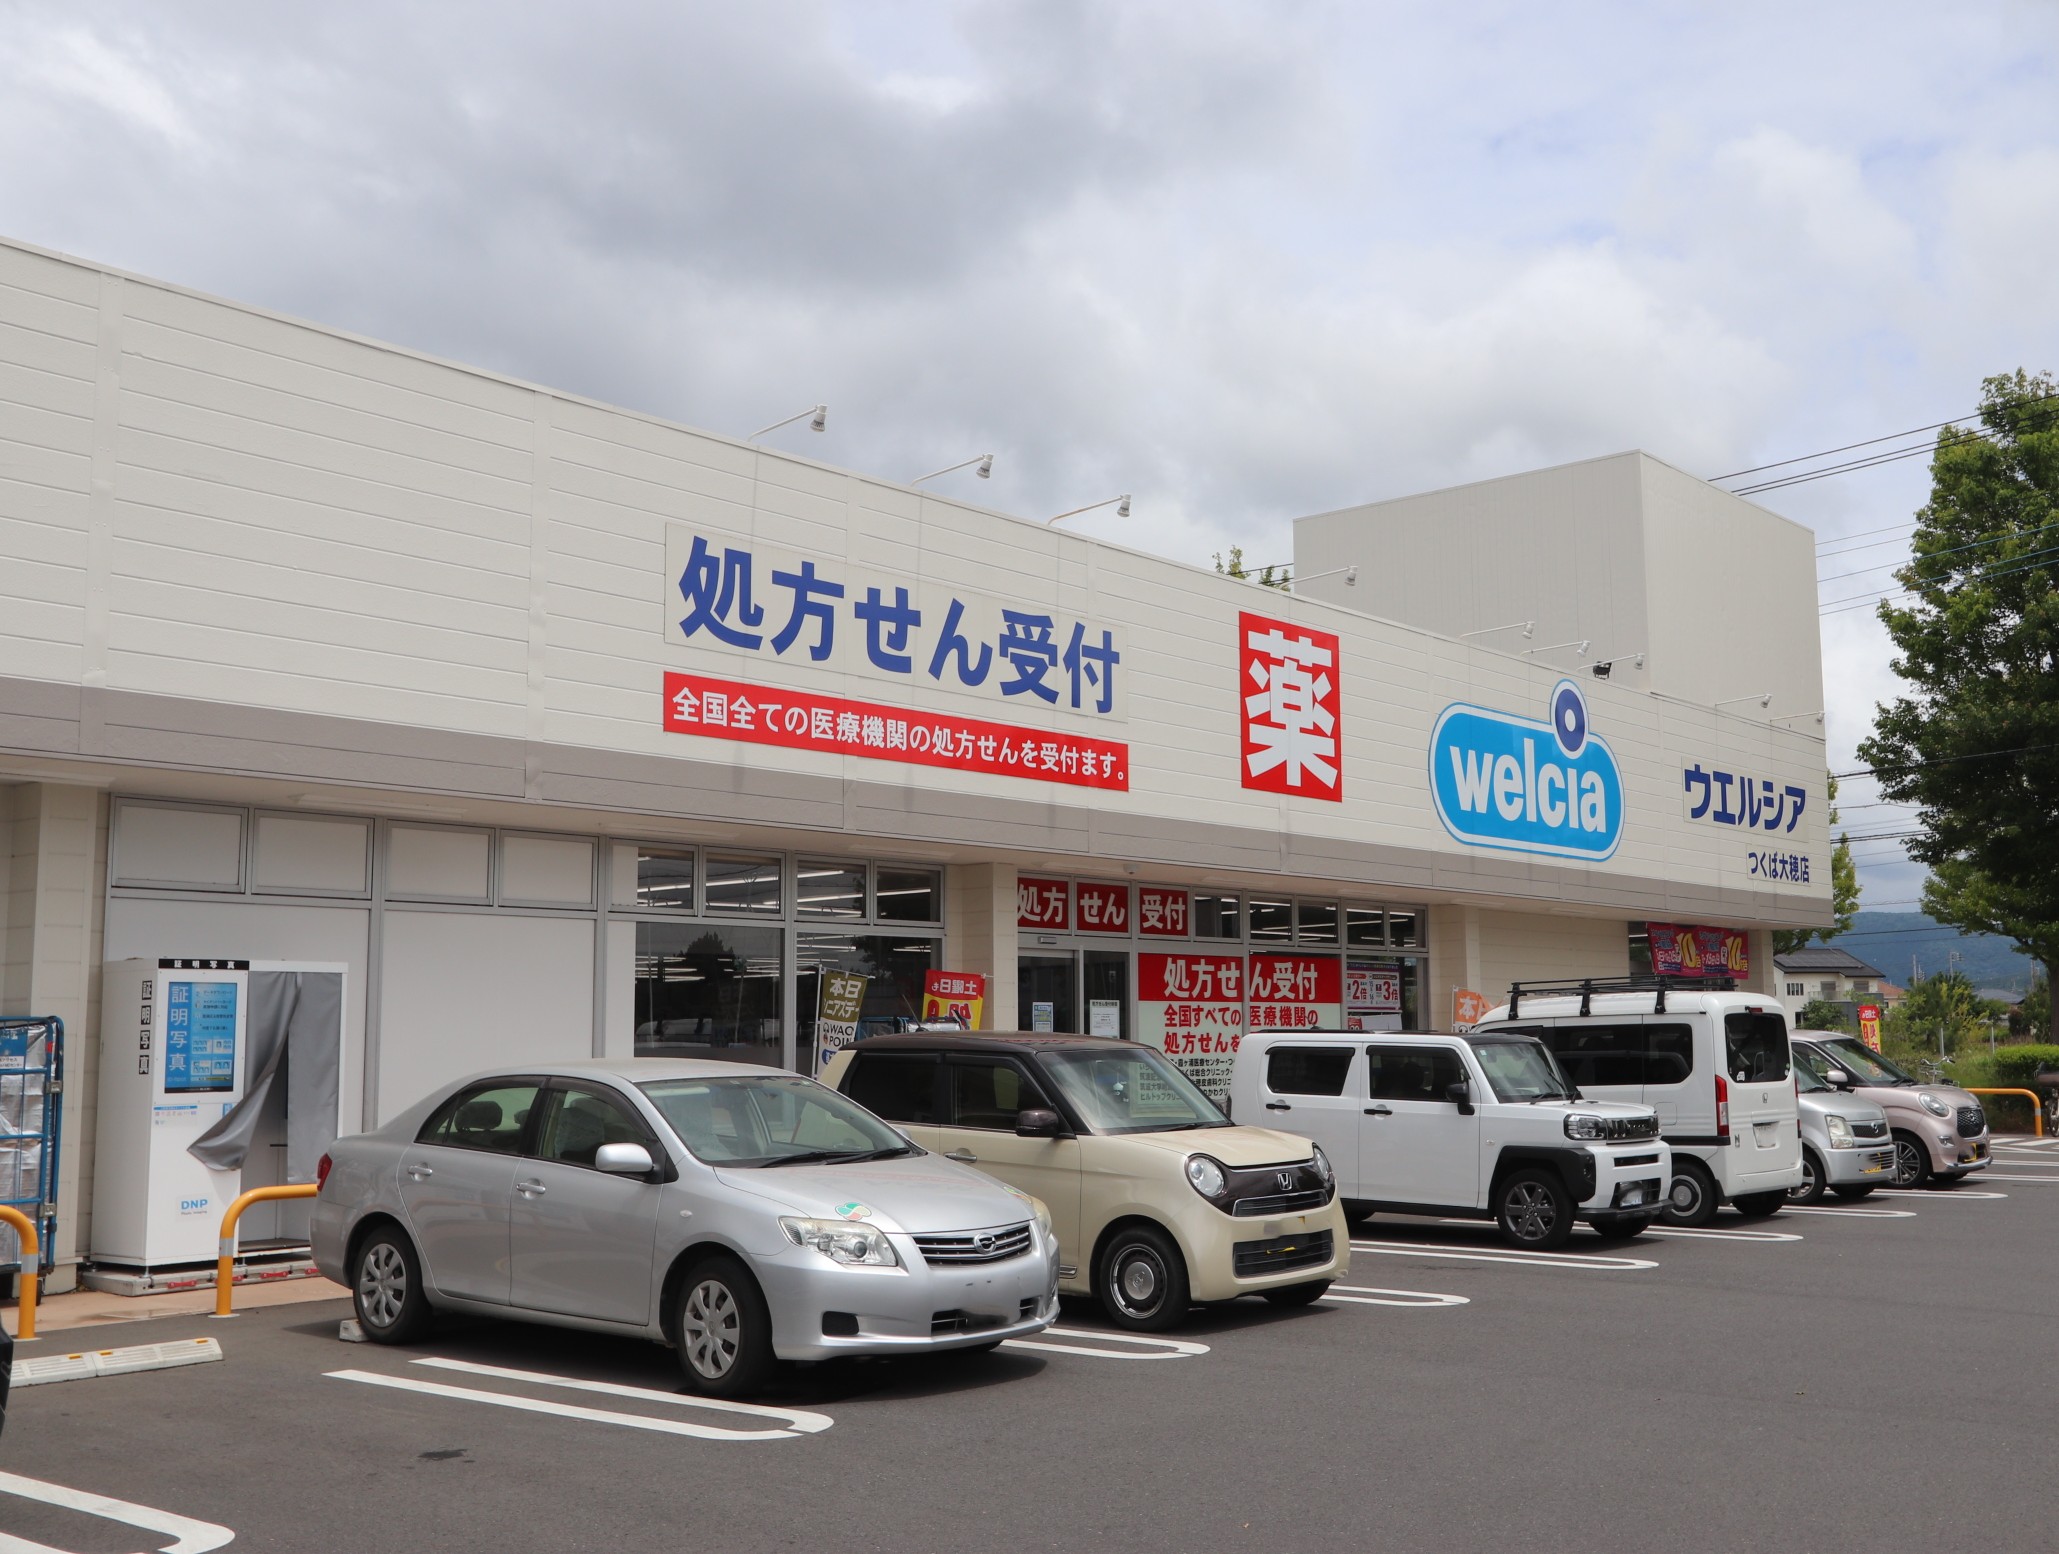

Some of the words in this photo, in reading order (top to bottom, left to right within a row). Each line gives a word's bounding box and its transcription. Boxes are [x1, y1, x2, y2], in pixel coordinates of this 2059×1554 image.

[678, 535, 1120, 714] 処方せん受付
[672, 686, 1125, 782] 全国全ての医療機関の処方せんを受付ます。
[1245, 629, 1338, 789] 薬
[1449, 737, 1606, 833] welcia
[1684, 764, 1806, 834] ウエルシア
[1748, 851, 1810, 884] つくば大穂店
[1017, 884, 1066, 923] 処方
[1080, 891, 1126, 926] せん
[1141, 895, 1186, 931] 受付
[829, 978, 862, 999] 本日
[1164, 958, 1318, 1000] 処方せん受付
[139, 981, 152, 1074] 証明写真
[169, 986, 189, 1071] 証明写真
[181, 1199, 208, 1210] DNP
